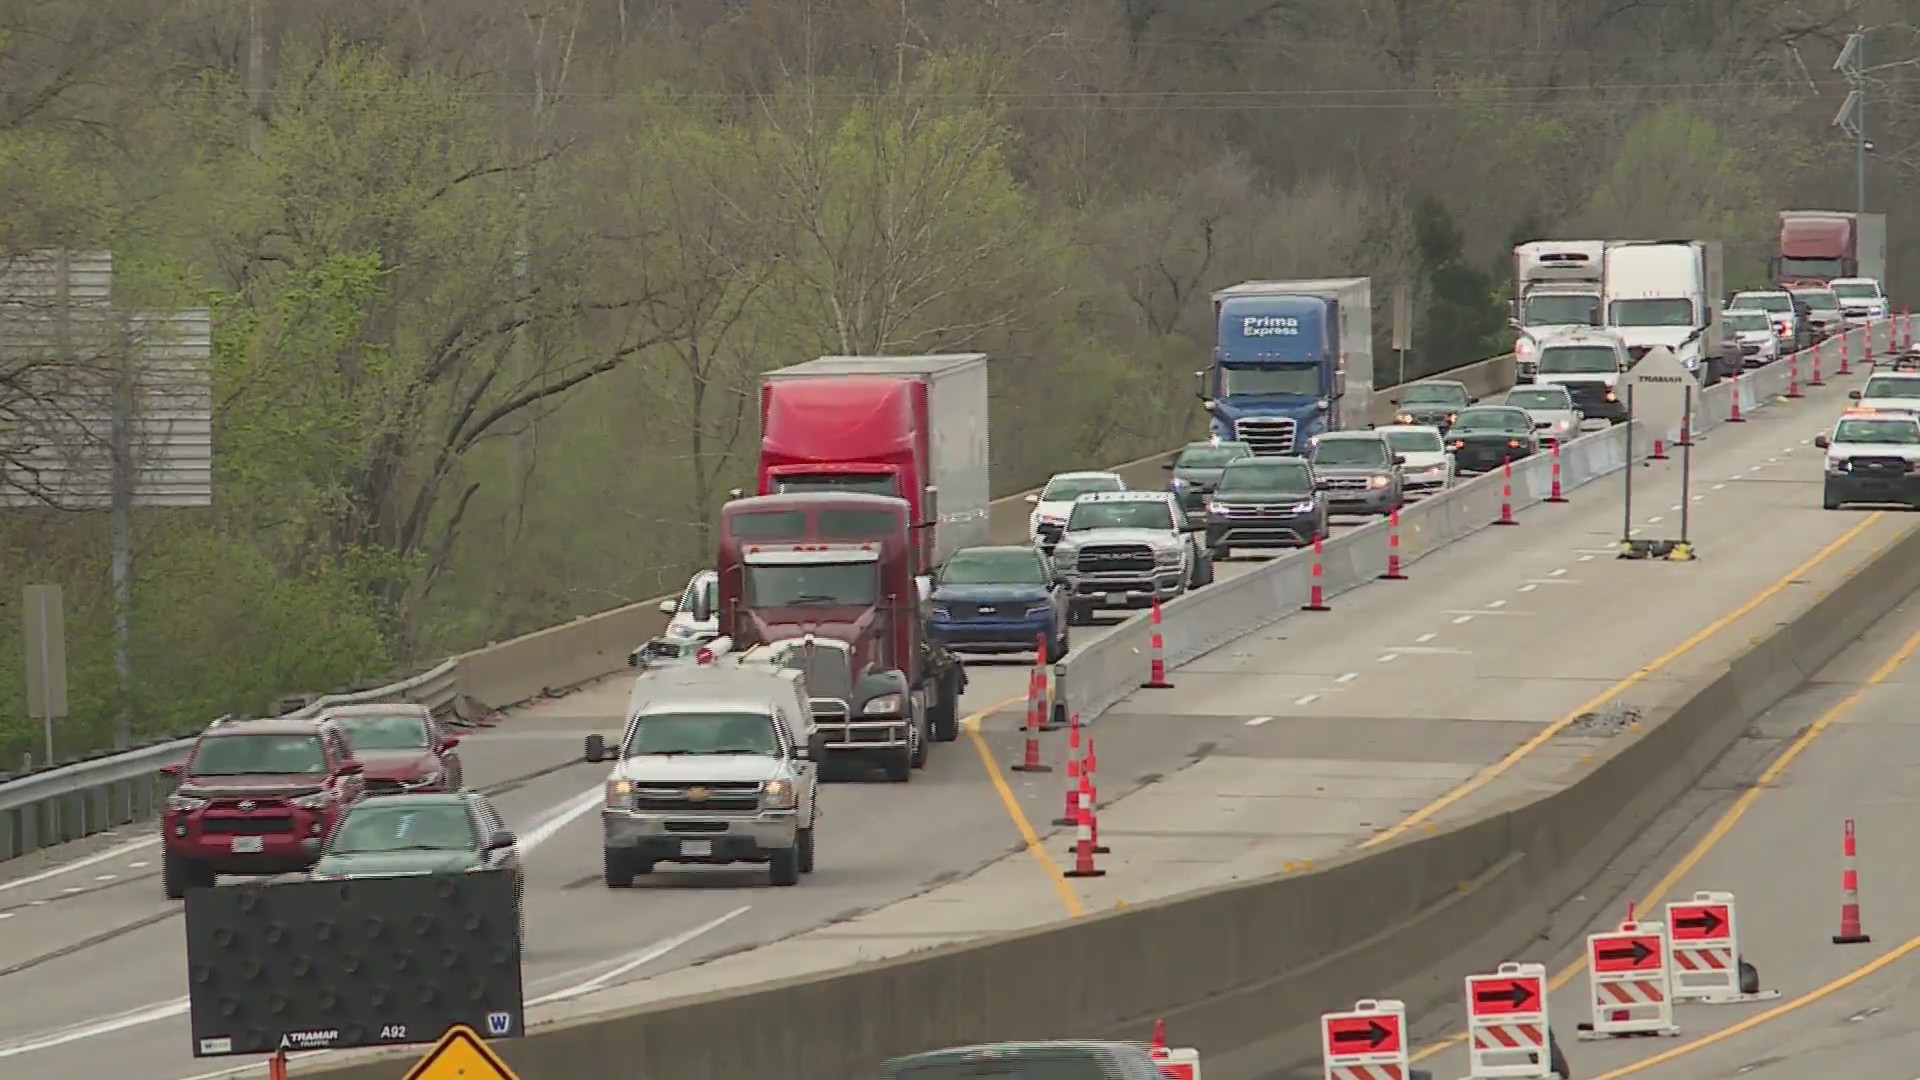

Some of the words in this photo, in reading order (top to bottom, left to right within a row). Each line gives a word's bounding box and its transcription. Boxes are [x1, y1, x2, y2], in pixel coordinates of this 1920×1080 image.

[1243, 316, 1298, 327] Prima
[1243, 326, 1298, 337] Express
[490, 1015, 507, 1031] W
[290, 1030, 339, 1042] TRAMAR
[380, 1025, 406, 1038] A92
